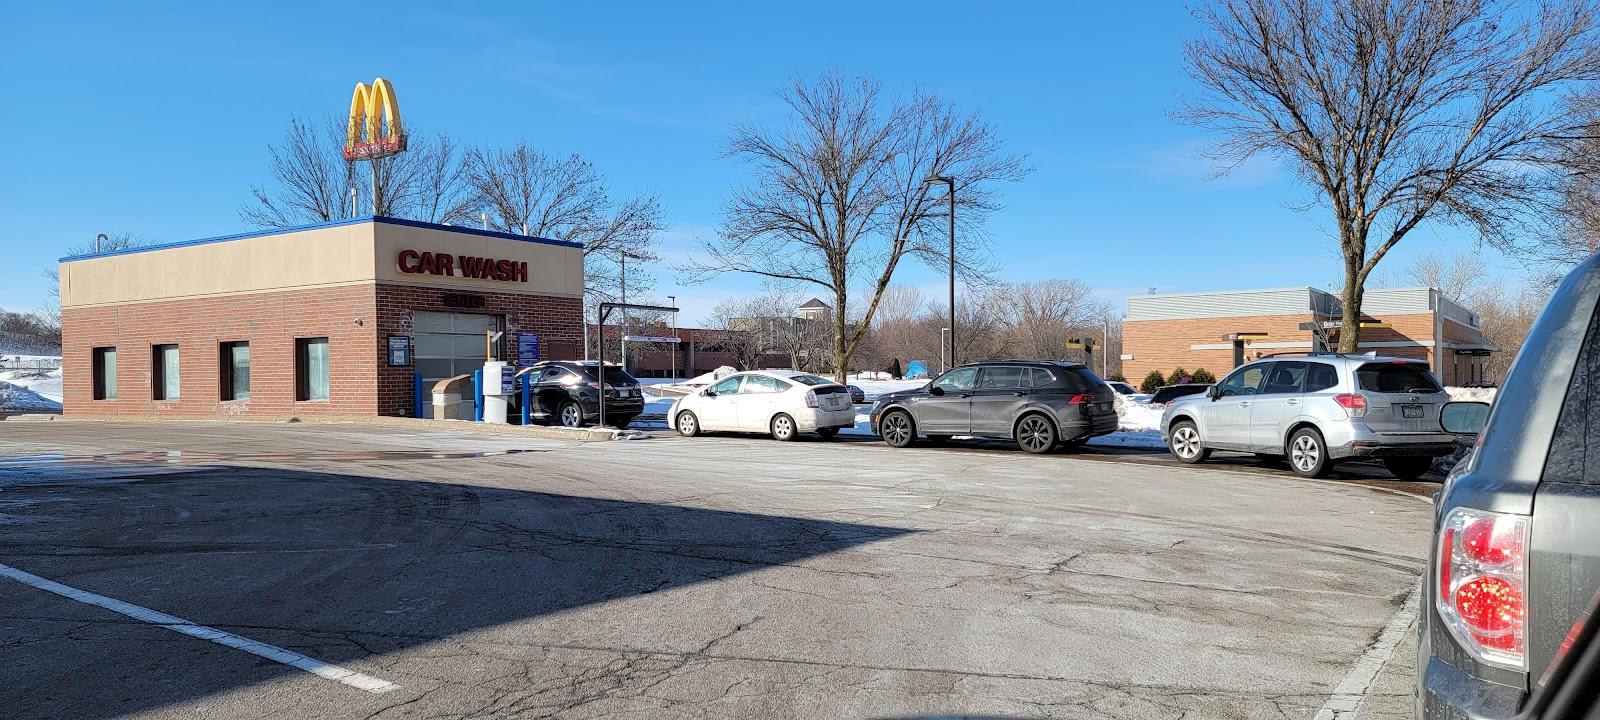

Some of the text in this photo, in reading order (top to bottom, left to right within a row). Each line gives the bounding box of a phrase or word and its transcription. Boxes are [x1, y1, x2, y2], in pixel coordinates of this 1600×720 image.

[398, 249, 528, 282] CAR WASH
[446, 293, 486, 308] ENTER
